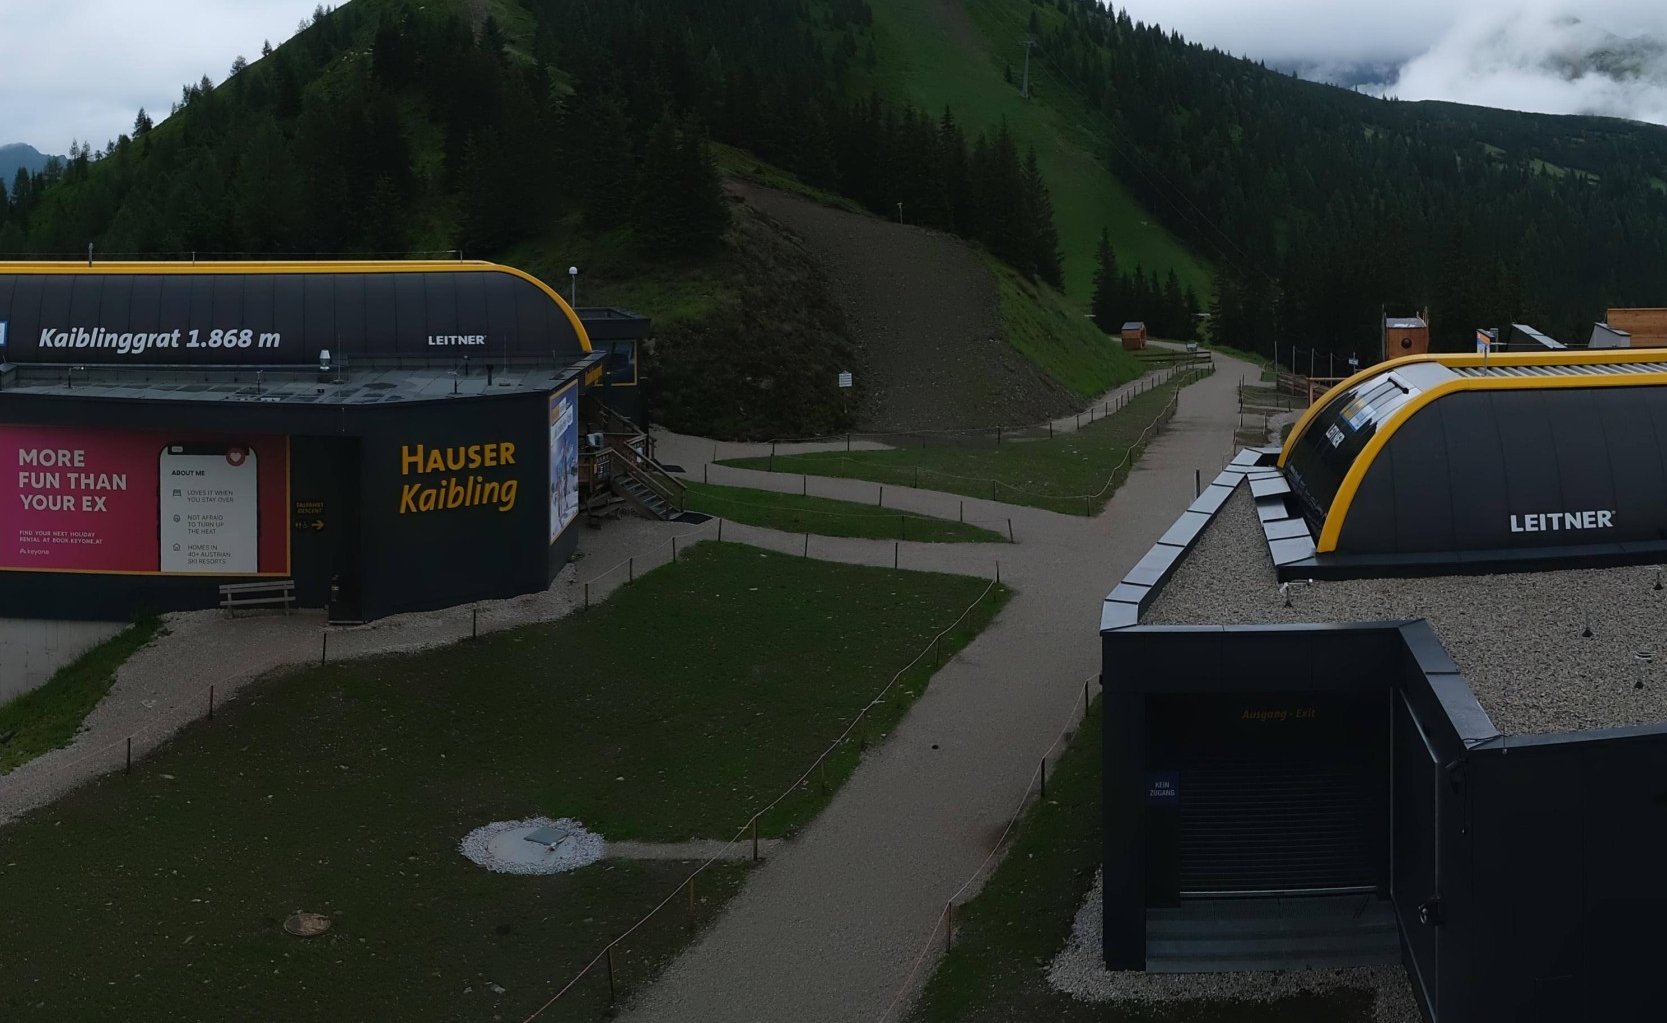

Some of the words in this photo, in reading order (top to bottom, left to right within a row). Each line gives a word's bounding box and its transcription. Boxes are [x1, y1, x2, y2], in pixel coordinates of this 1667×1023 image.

[39, 327, 181, 354] Kaiblinggrat
[186, 329, 253, 348] 1.868
[258, 332, 280, 348] m
[428, 335, 485, 346] LEITNER
[19, 449, 85, 467] MORE
[402, 441, 516, 475] HAUSER
[19, 472, 60, 489] FUN
[67, 473, 127, 490] THAN
[20, 495, 76, 511] YOUR
[82, 496, 108, 512] EX
[400, 475, 518, 514] Kaibling
[1510, 510, 1613, 532] LEITNER
